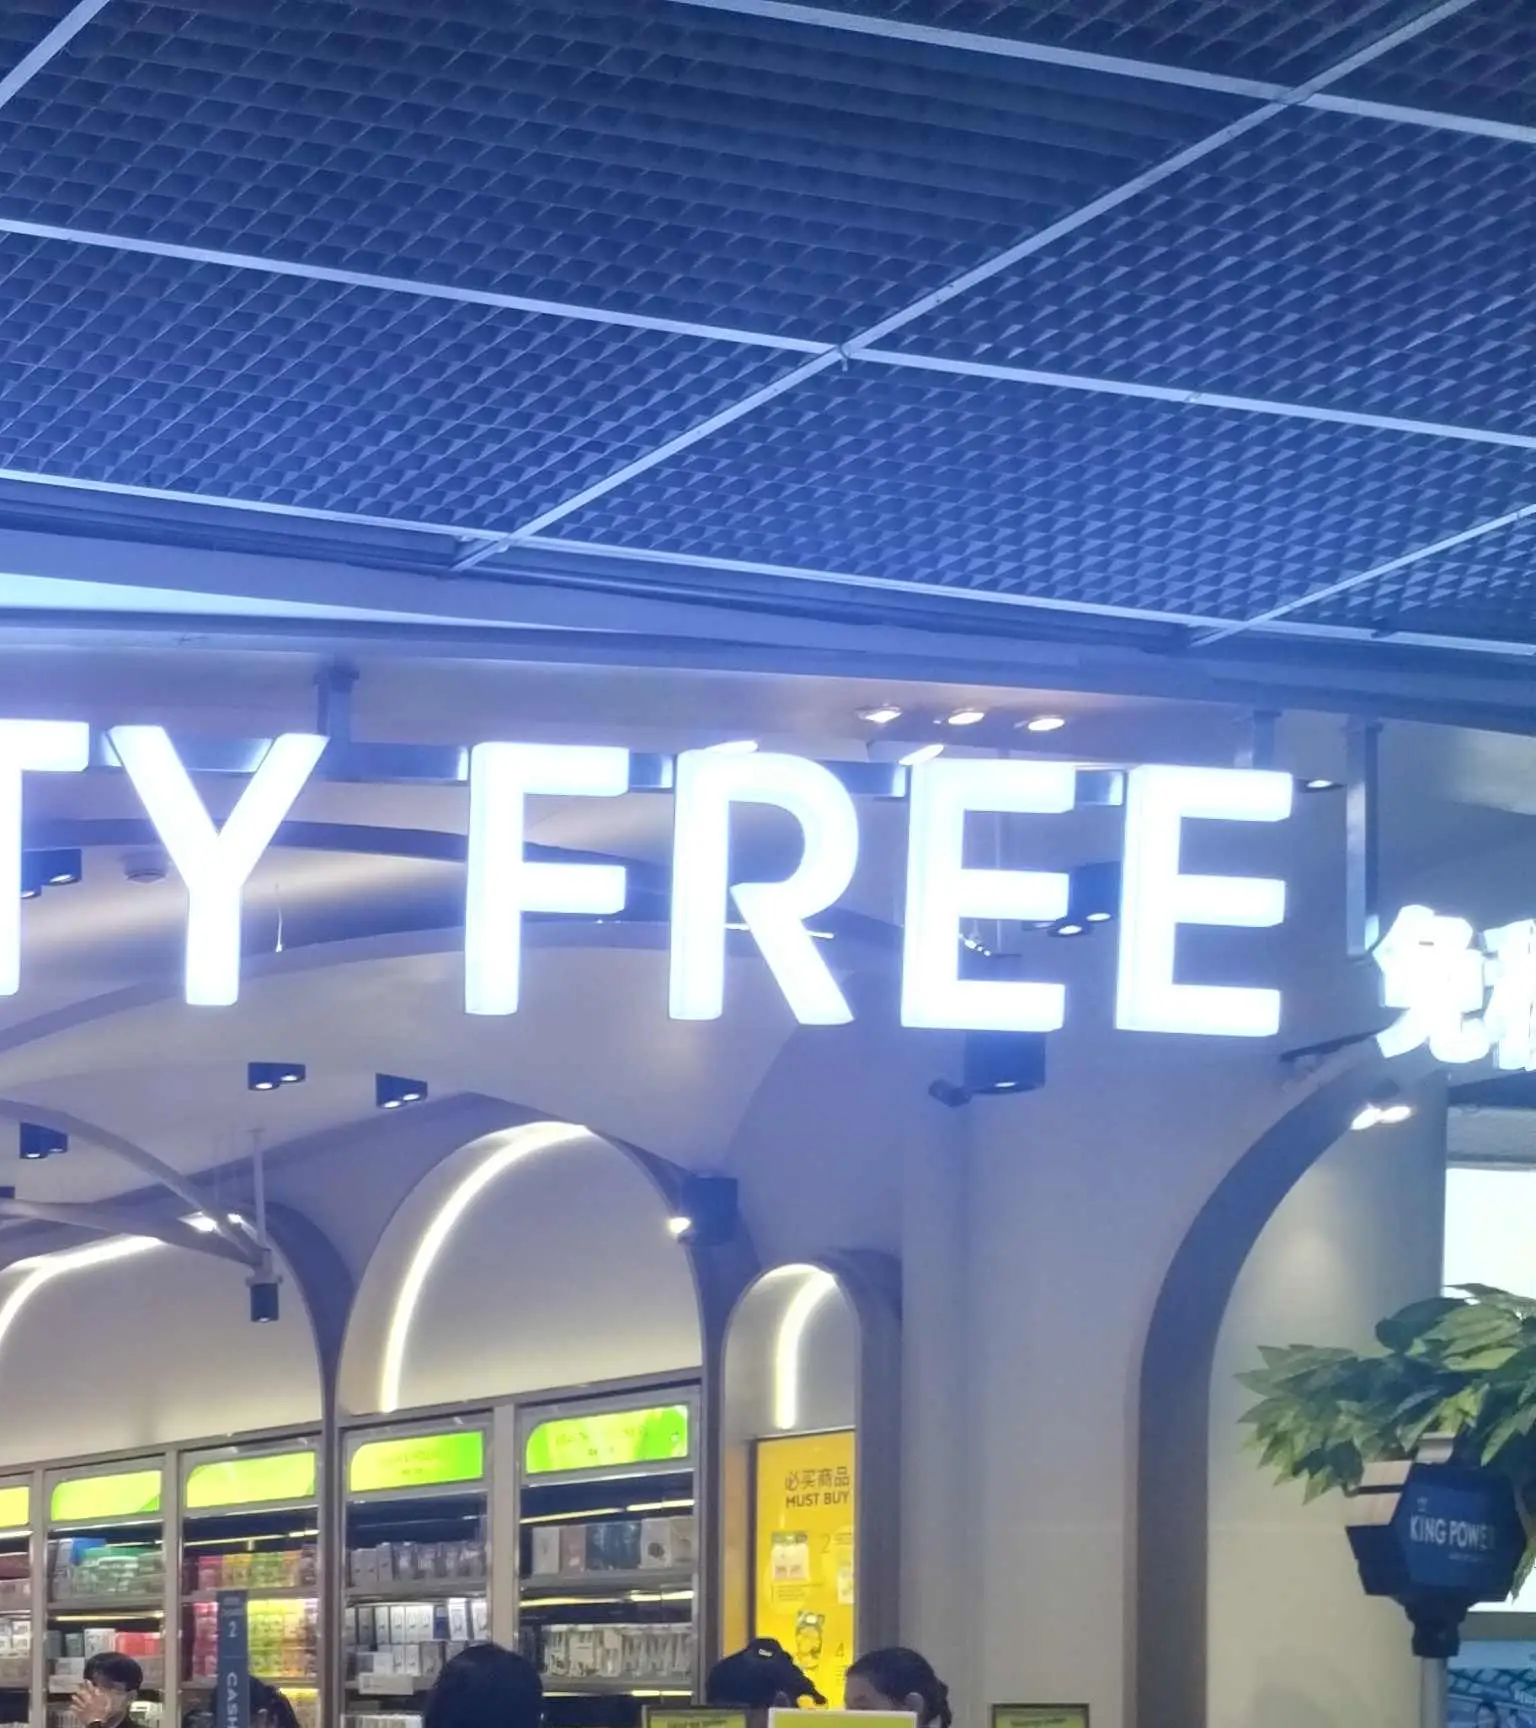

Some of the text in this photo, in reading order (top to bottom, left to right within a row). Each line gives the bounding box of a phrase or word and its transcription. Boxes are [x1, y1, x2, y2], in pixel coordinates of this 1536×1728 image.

[463, 738, 1294, 1036] FREE
[785, 1466, 850, 1491] 必买商品
[785, 1490, 851, 1509] MUST BUY
[1410, 1515, 1447, 1545] KING
[229, 1621, 238, 1638] 2
